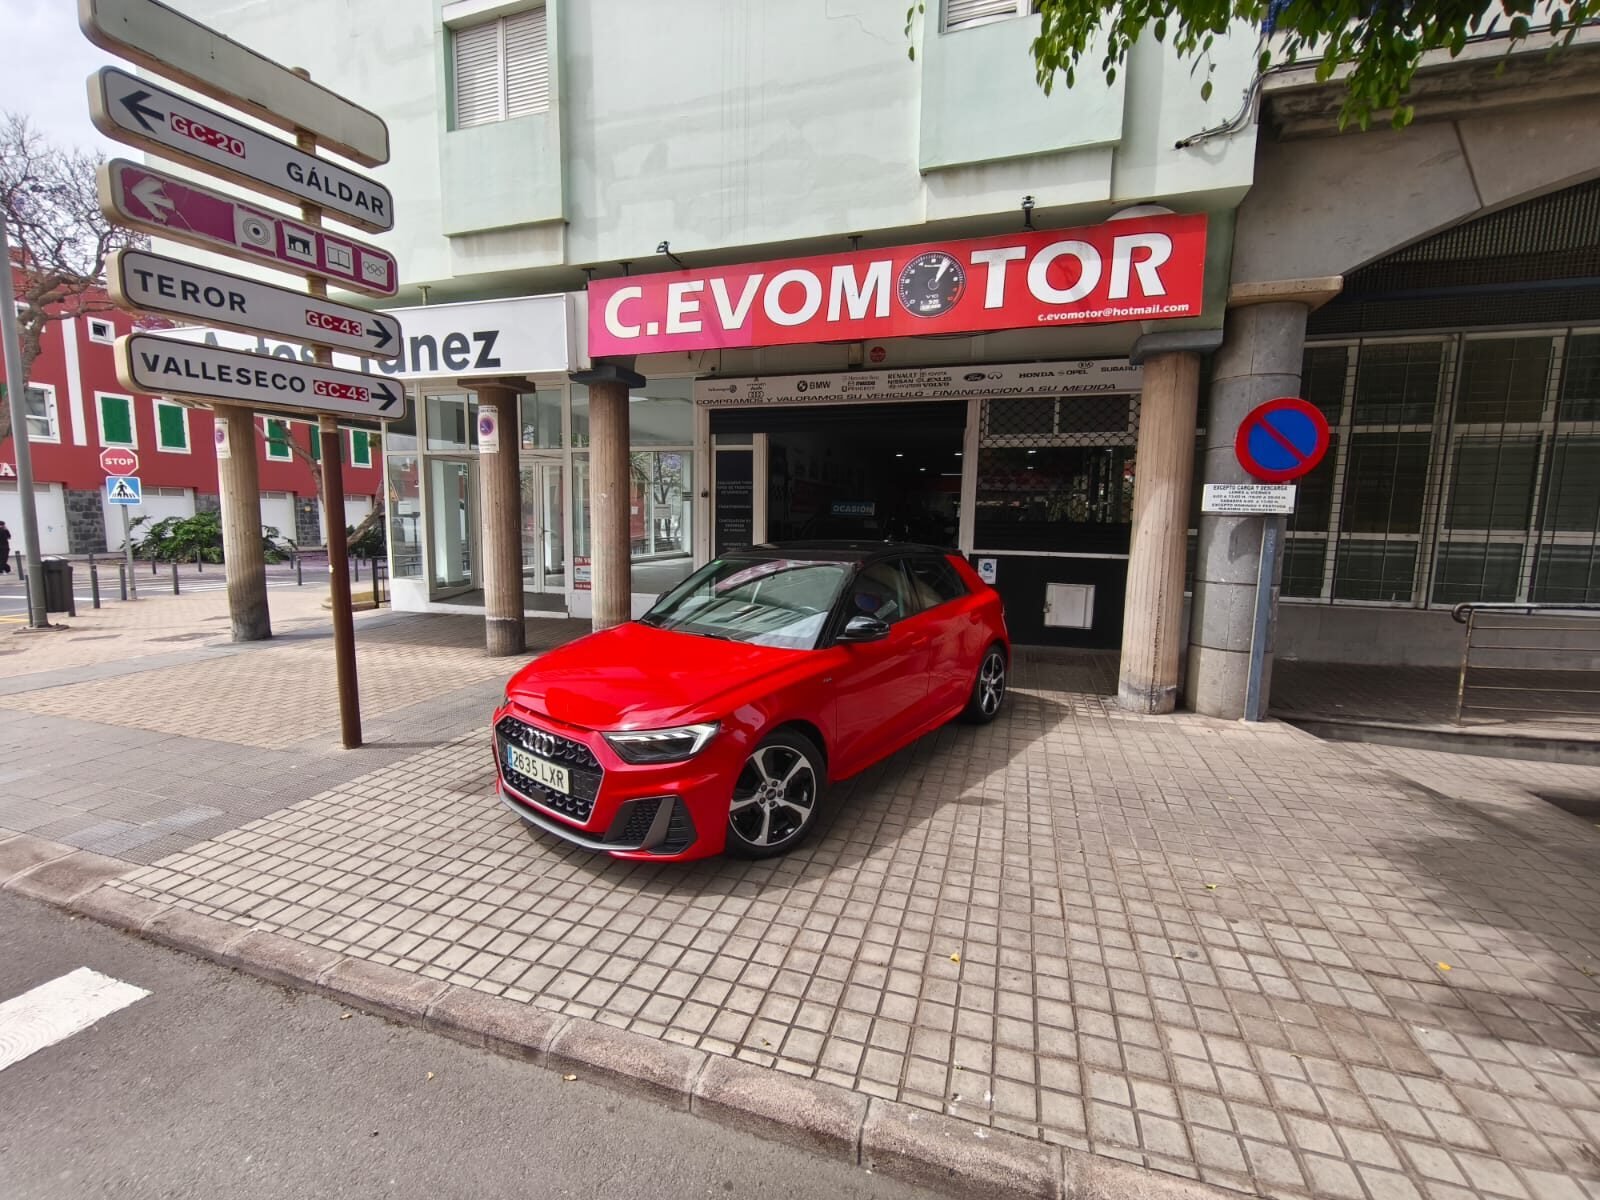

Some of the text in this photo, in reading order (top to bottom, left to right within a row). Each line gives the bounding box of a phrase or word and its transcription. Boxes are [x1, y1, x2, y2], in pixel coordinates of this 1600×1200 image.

[171, 114, 246, 159] GC-20
[286, 161, 385, 218] GÁLDAR
[133, 268, 248, 314] TEROR
[306, 310, 363, 337] GC-43
[1037, 303, 1190, 322] c.evomotor@hotmail.com
[141, 352, 306, 394] VALLESECO
[809, 380, 831, 390] BMW
[1018, 371, 1055, 379] HONDA
[314, 380, 370, 403] GC-43
[696, 397, 761, 406] COMPRAMOS
[776, 393, 843, 402] VALORAMOS
[846, 392, 862, 400] SU
[866, 391, 923, 400] VEHICULO
[932, 387, 1022, 397] FINANCIACION
[1026, 385, 1035, 393] A
[1038, 384, 1058, 392] SU
[1062, 383, 1116, 392] MEDIDA
[104, 457, 134, 466] STOP
[513, 750, 564, 790] 2635 LXR
